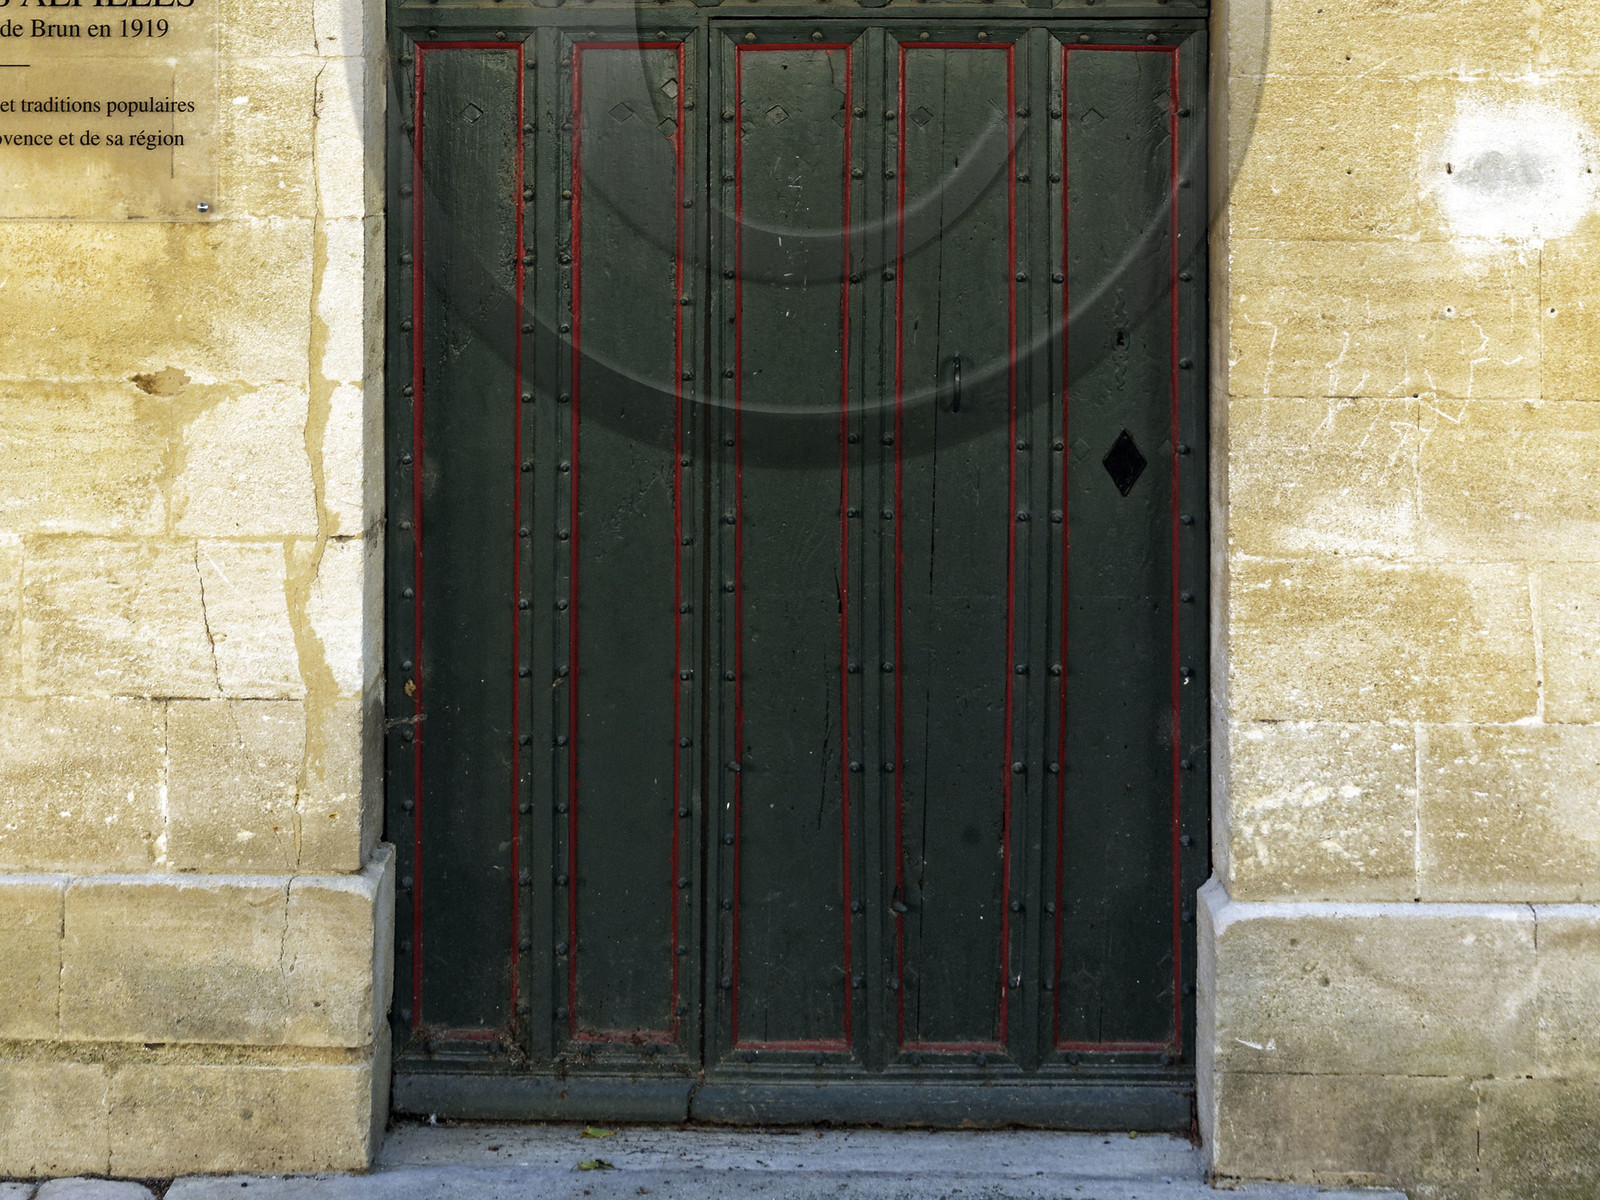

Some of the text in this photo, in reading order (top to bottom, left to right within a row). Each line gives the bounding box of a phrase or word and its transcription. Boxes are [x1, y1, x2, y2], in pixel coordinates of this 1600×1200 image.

[0, 18, 169, 38] de Brun en 1919
[0, 96, 195, 117] et traditions populaires
[0, 129, 185, 151] vence et de sa région
